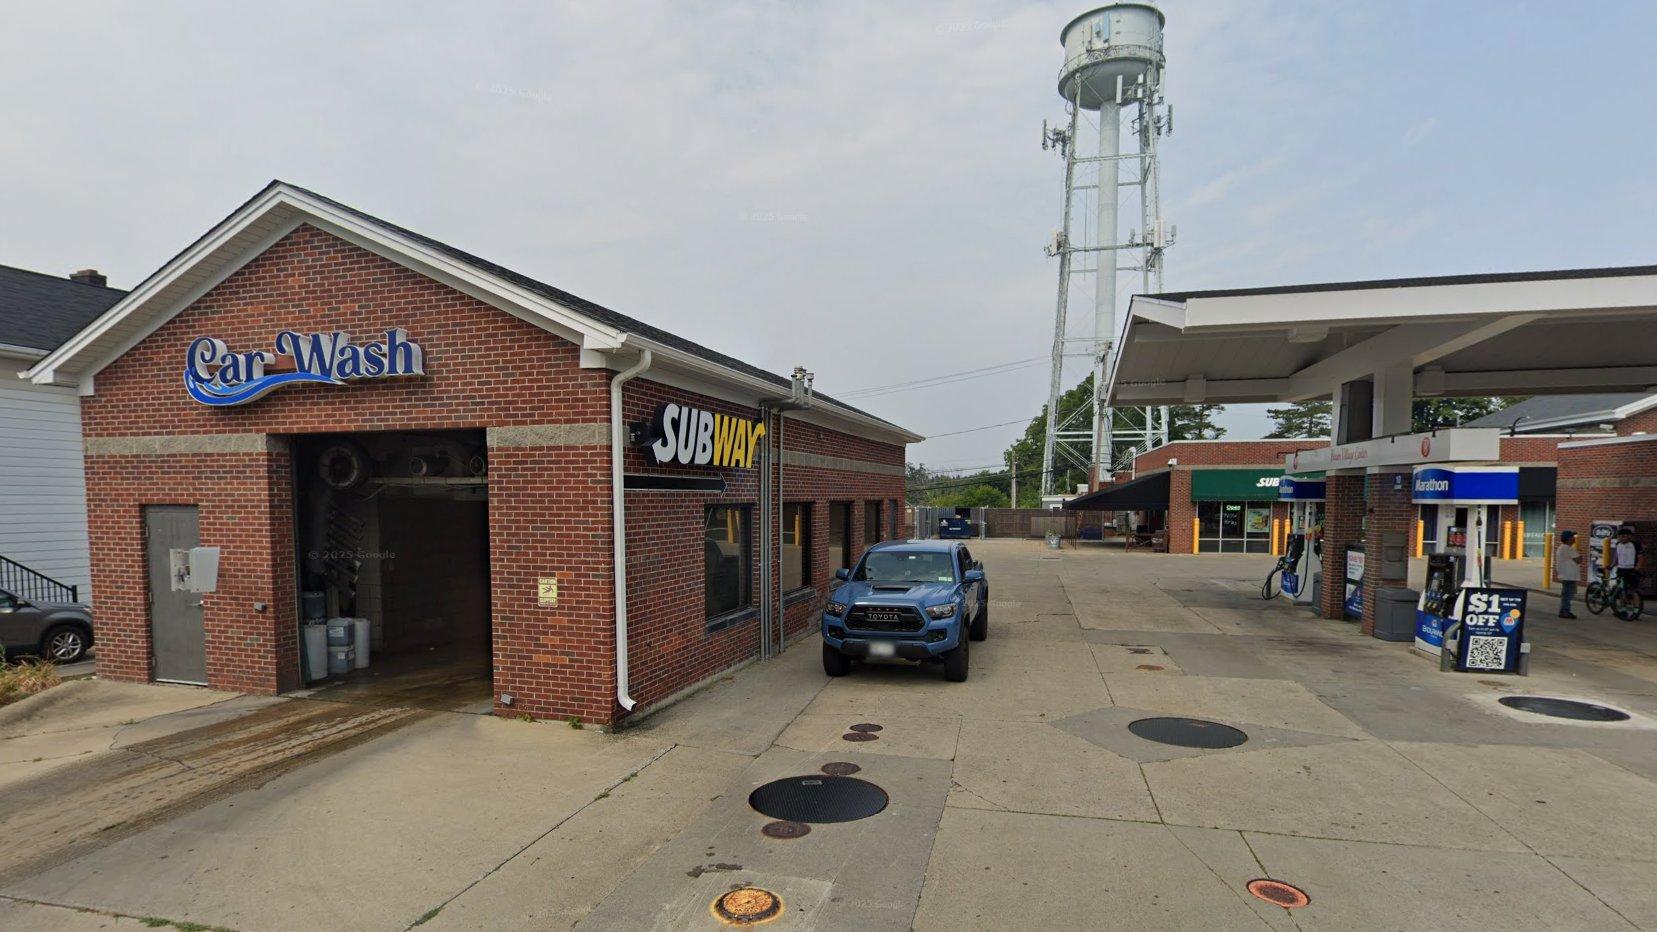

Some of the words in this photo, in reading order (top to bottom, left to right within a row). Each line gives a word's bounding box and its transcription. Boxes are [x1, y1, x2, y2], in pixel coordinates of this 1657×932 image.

[186, 337, 266, 385] Car
[275, 328, 419, 378] Wash
[652, 403, 766, 469] SUBWAY
[1256, 477, 1280, 488] SUB
[1415, 478, 1449, 492] Marathon
[1467, 591, 1501, 614] $1
[867, 612, 899, 620] TOYOTA
[1465, 613, 1500, 626] OFF
